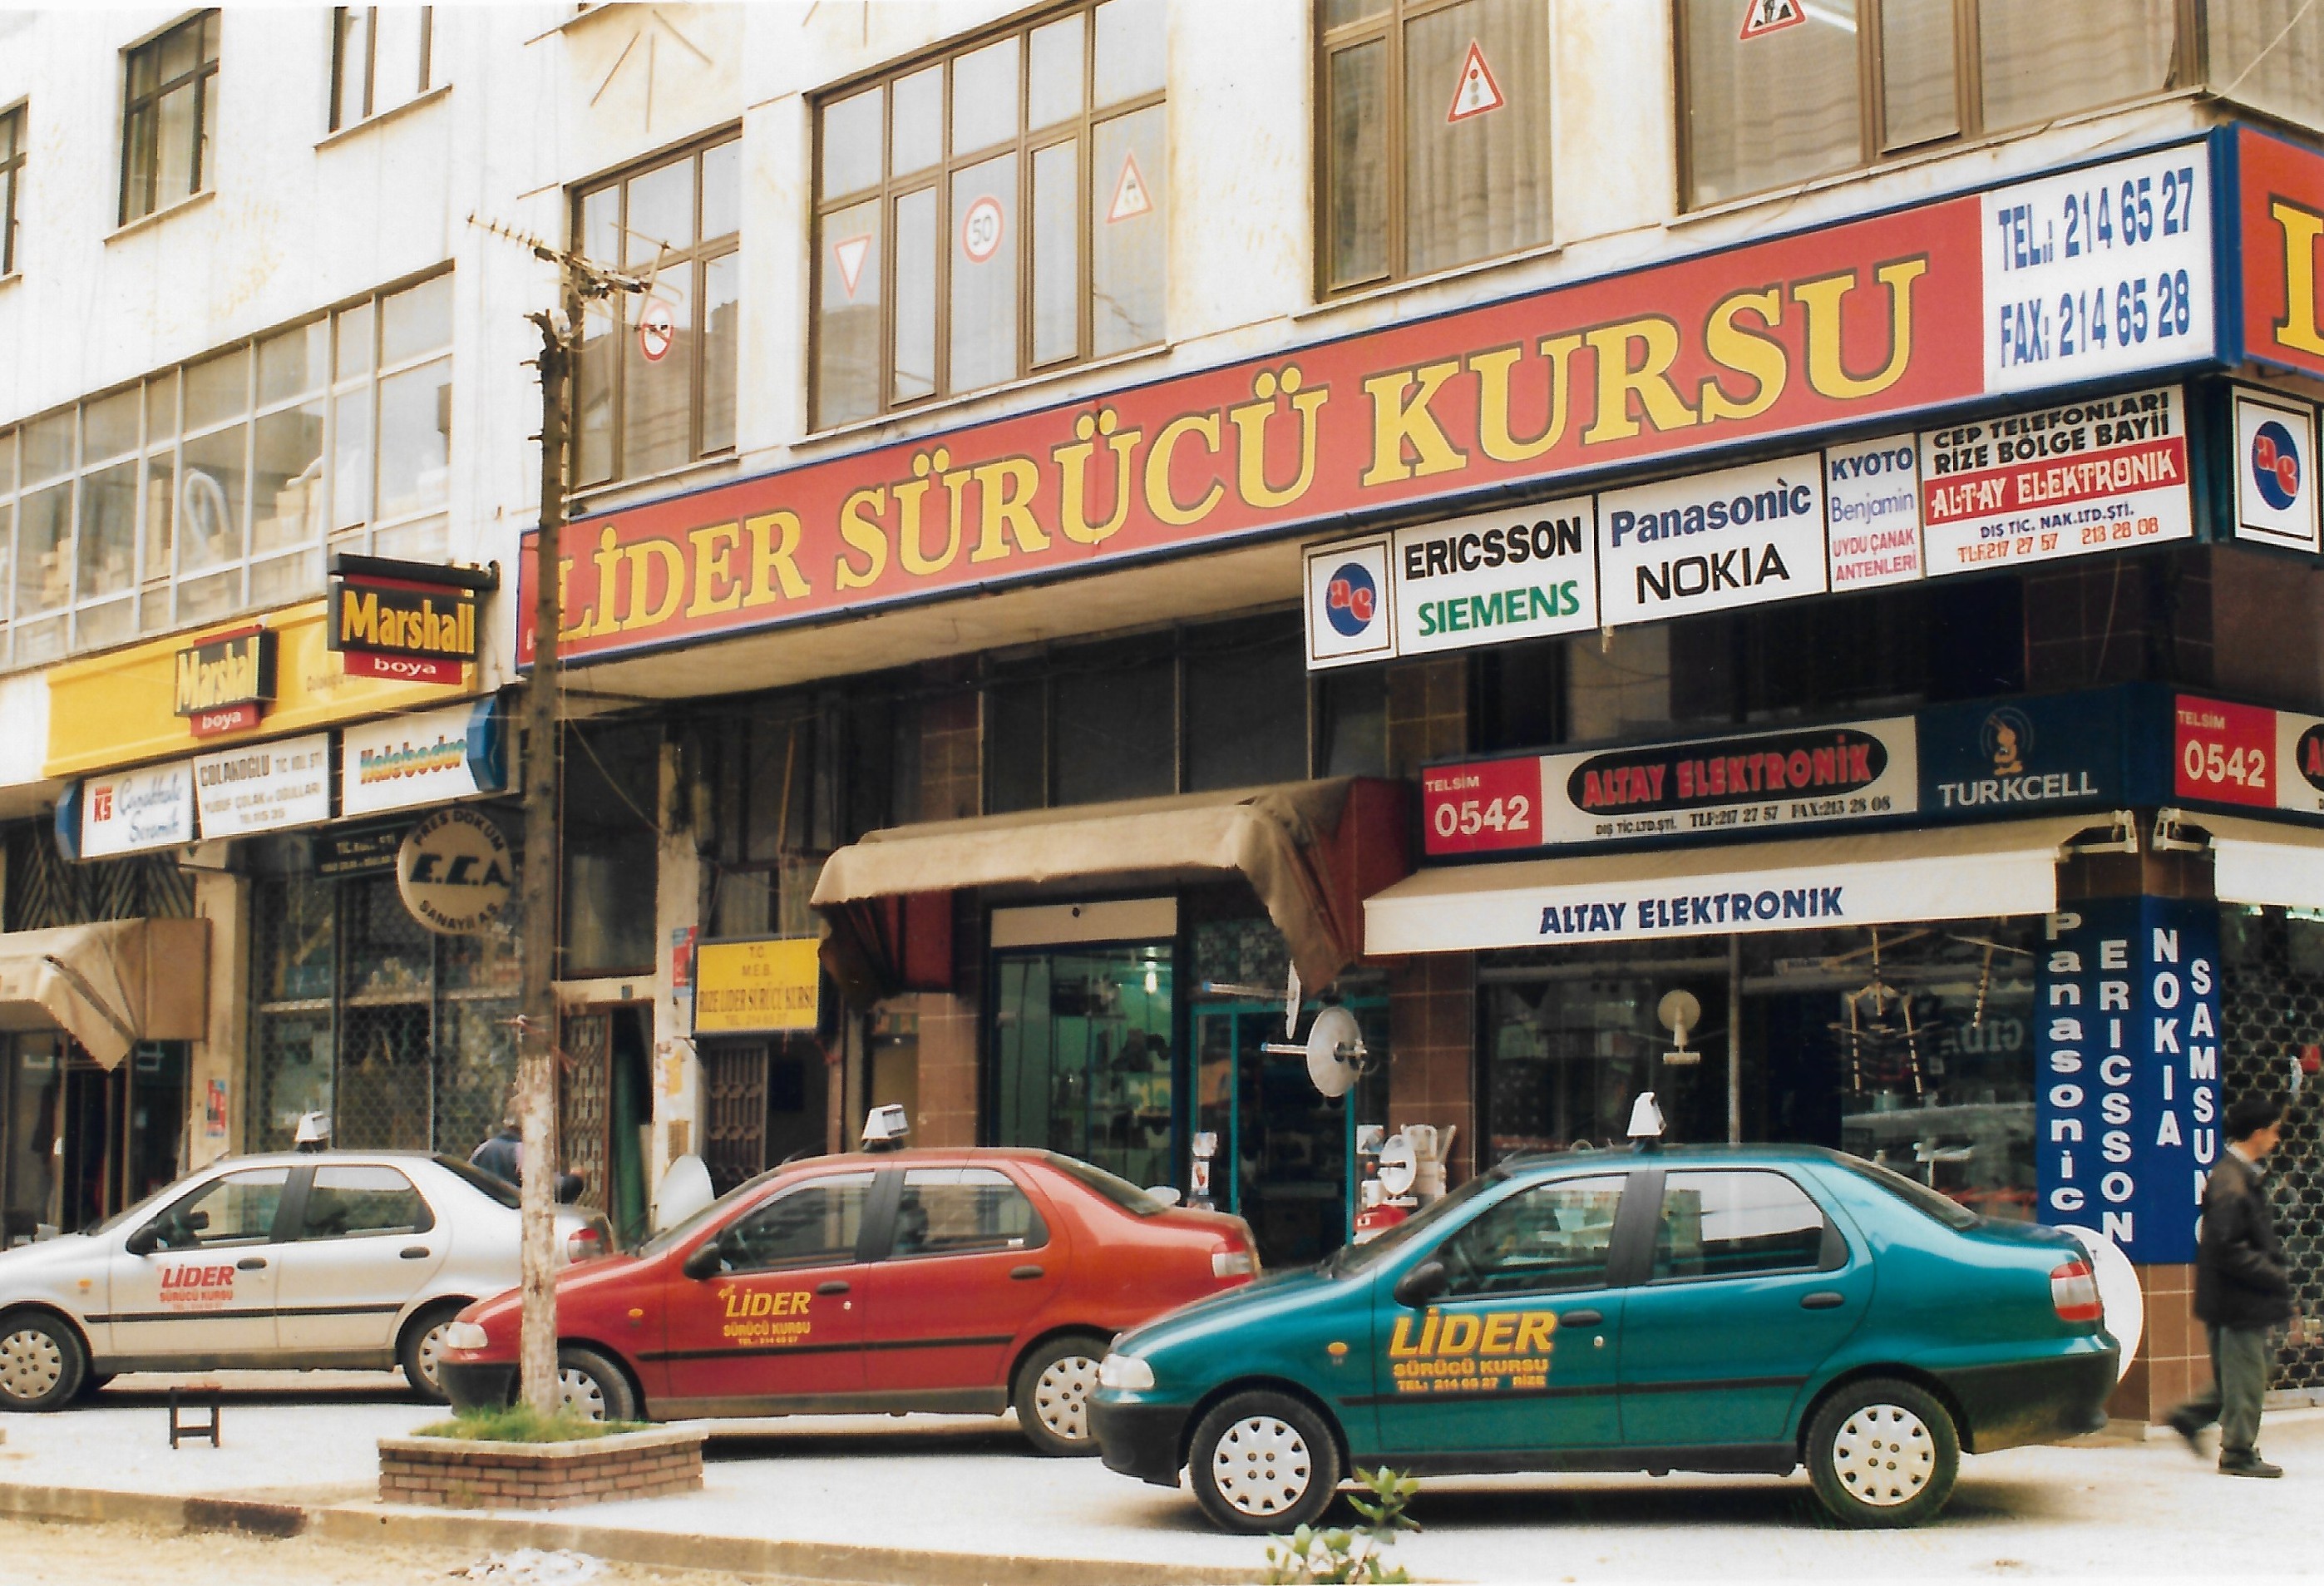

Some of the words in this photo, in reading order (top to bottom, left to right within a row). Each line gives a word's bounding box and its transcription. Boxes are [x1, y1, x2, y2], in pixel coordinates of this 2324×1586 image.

[973, 215, 993, 246] 50
[2064, 186, 2113, 259] 214
[2120, 177, 2153, 246] 65
[2162, 167, 2193, 236] 27
[2001, 298, 2050, 368] FAX:
[2059, 287, 2107, 358] 214
[2116, 277, 2148, 348] 65
[2157, 268, 2190, 339] 28
[835, 366, 1329, 590] SÜRÜCÜ
[1362, 259, 1927, 487] KURSU
[1933, 427, 1982, 448] CEP
[1990, 392, 2169, 440] TELEFONLARI
[1831, 447, 1913, 482] KYOTO
[1934, 443, 1988, 475] RİZE
[1997, 427, 2085, 464] BÖLGE
[1611, 477, 1812, 547] Panasonic
[1832, 487, 1914, 525] Benjamin
[1931, 477, 2007, 519] ALTAY
[1405, 516, 1581, 581] ERICSSON
[1833, 536, 1868, 559] UYDU
[1870, 528, 1914, 555] ÇANAK
[2016, 536, 2034, 555] 27
[2040, 532, 2059, 551] 57
[2081, 526, 2106, 545] 213
[2113, 521, 2132, 540] 28
[2138, 516, 2159, 536] 08
[1636, 542, 1790, 604] NOKIA
[342, 590, 476, 655] Marshall
[1419, 580, 1580, 637] SIEMENS
[374, 658, 437, 677] boya
[202, 711, 242, 730] boya
[2178, 710, 2226, 730] TELSİM
[1425, 773, 1479, 793] TELSİM
[1581, 764, 1667, 808] ALTAY
[1676, 734, 1873, 798] ELEKTRONİK
[2184, 739, 2266, 788] 0542
[1743, 808, 1759, 823] 27
[1764, 805, 1779, 821] 57
[1871, 795, 1891, 812] 08
[1938, 772, 2098, 808] TURKCELL
[1434, 794, 1530, 837] 0542
[1539, 901, 1626, 935] ALTAY
[1637, 886, 1843, 930] ELEKTRONIK
[2152, 927, 2183, 1147] NOKIA
[2045, 912, 2085, 1212] Panasonic
[2099, 938, 2134, 1243] ERICSSON
[2188, 958, 2215, 1245] SAMSUN
[161, 1263, 234, 1289] LİDER
[725, 1288, 812, 1318] LİDER
[772, 1321, 812, 1335] KURSU
[1389, 1307, 1558, 1357] LİDER
[1393, 1357, 1476, 1378] SÜRÜCÜ
[1479, 1358, 1550, 1375] KURSU
[1433, 1377, 1459, 1392] 214
[1461, 1376, 1479, 1391] 65
[1481, 1376, 1499, 1391] 27
